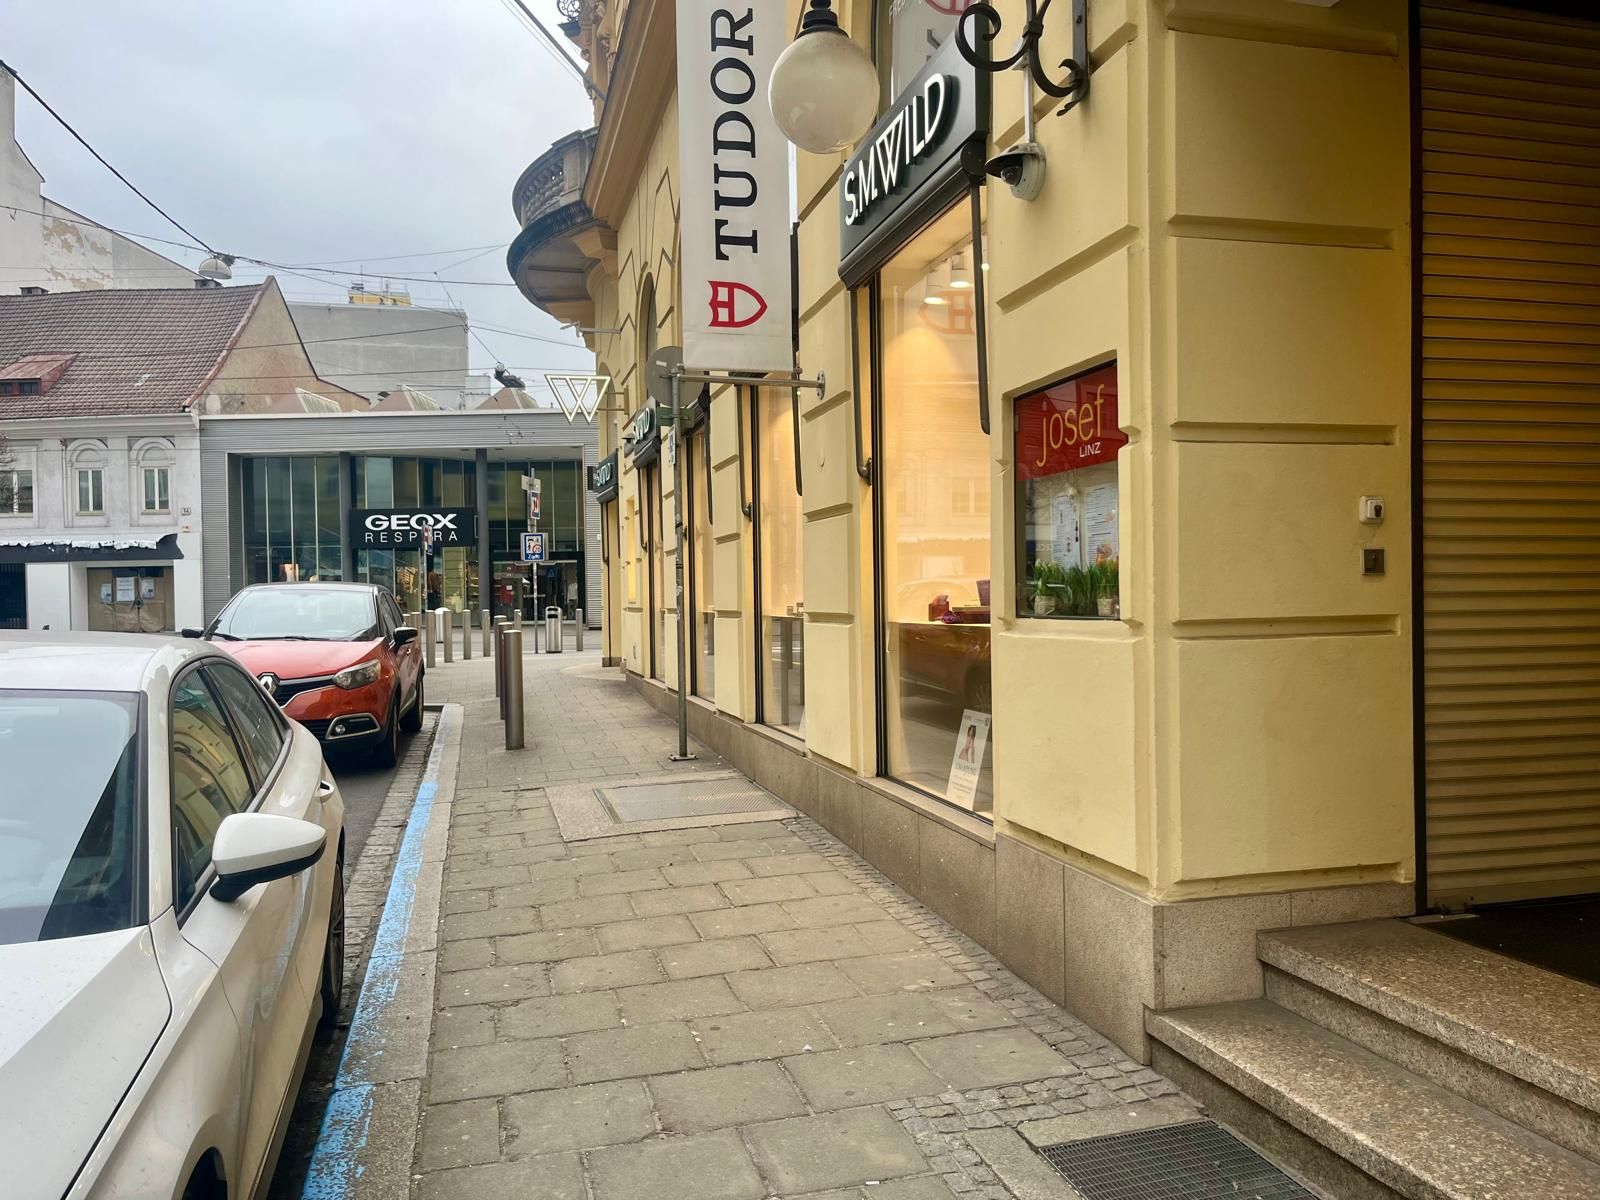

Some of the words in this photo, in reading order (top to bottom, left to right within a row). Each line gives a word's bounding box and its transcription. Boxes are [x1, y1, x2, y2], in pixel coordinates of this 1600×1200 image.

[710, 7, 758, 261] TUDOR
[1036, 384, 1105, 468] josef
[1079, 441, 1102, 458] LINZ
[365, 513, 458, 531] GEOX
[365, 531, 458, 543] RESPRA
